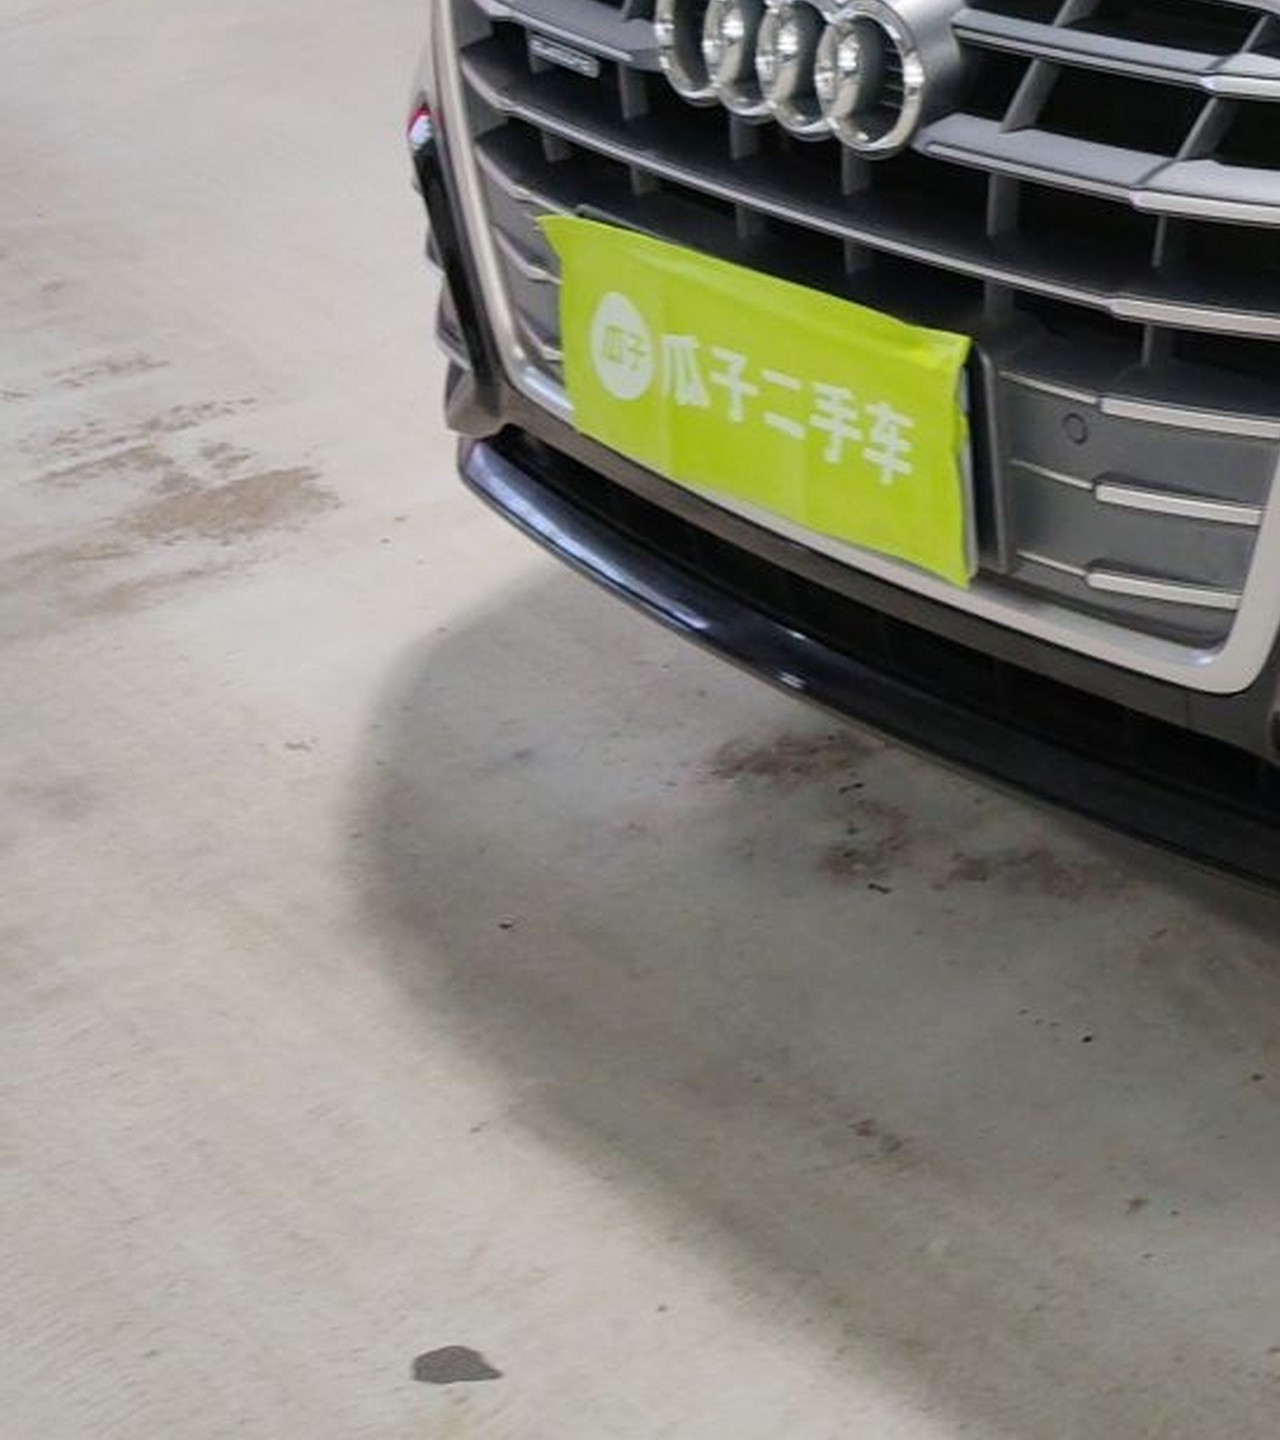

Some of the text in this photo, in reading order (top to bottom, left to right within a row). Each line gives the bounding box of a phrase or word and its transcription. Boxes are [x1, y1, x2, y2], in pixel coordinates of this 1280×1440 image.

[661, 333, 915, 485] 瓜子二手车
